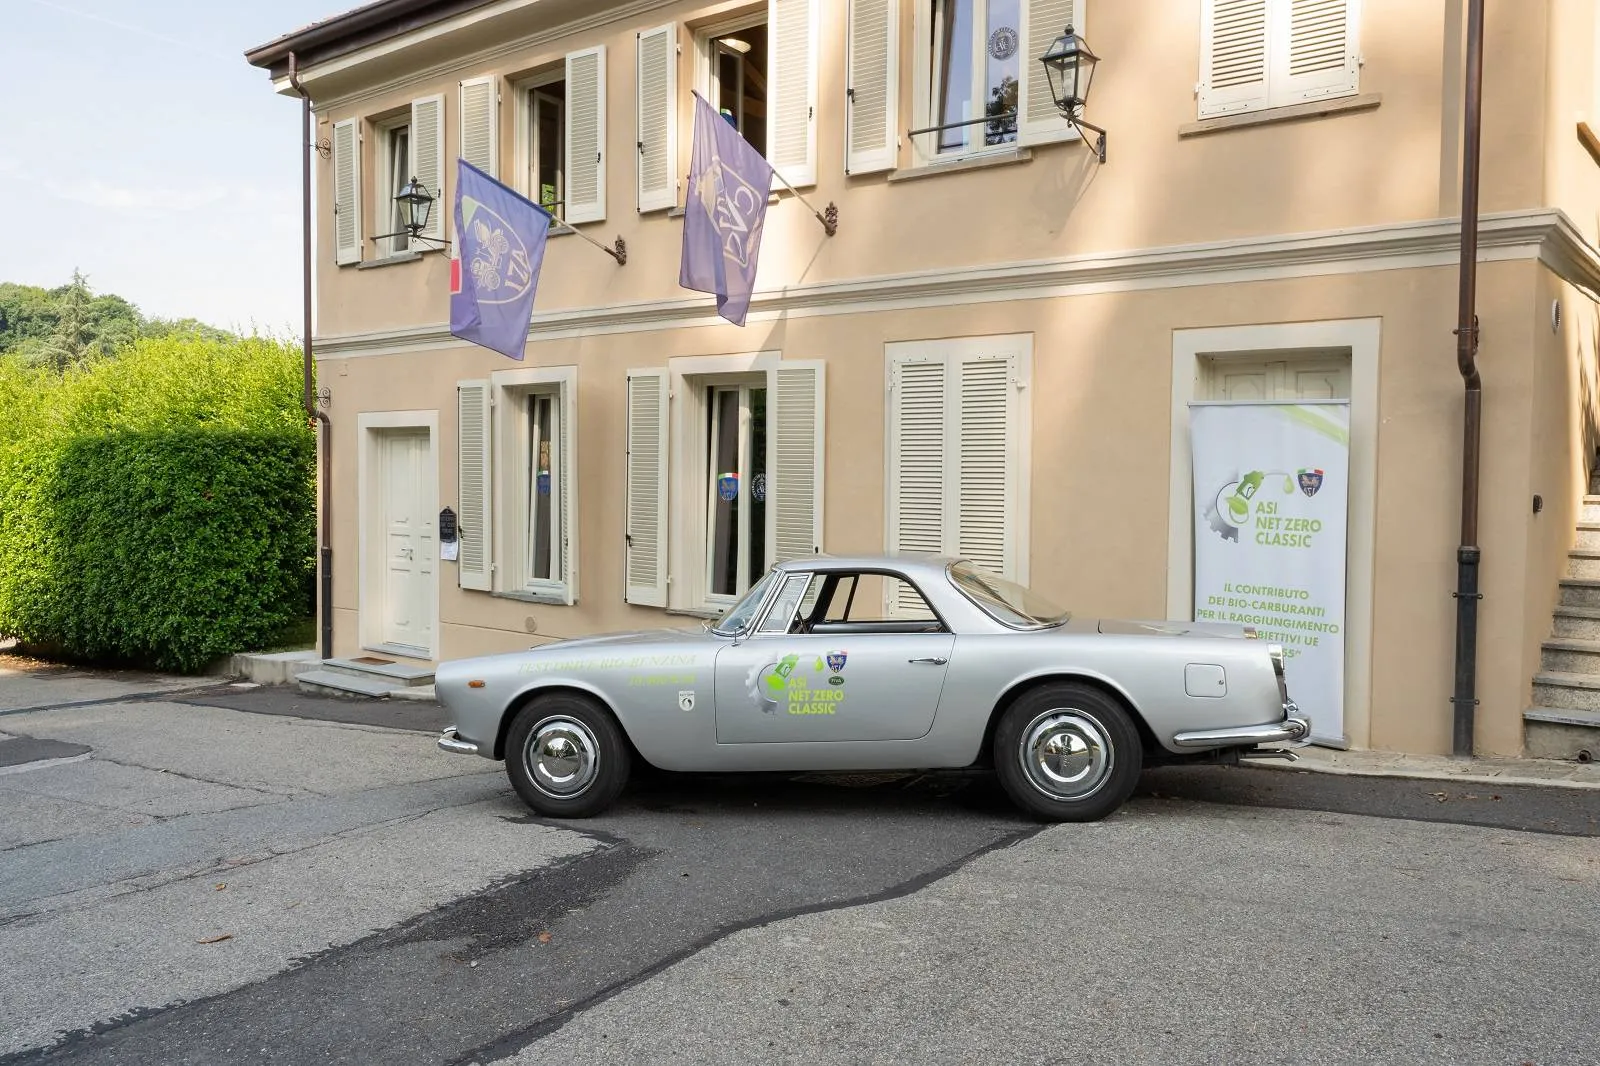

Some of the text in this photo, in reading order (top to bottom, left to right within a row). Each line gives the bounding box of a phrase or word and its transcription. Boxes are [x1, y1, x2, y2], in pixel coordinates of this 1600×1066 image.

[1255, 501, 1278, 514] ASI
[1255, 517, 1322, 533] NET ZERO
[1255, 532, 1312, 548] CLASSIC
[1224, 582, 1310, 600] IL CONTRIBUTO
[1208, 595, 1326, 617] DEI BIO-CARBURANTI
[1197, 608, 1340, 634] PER IL RAGGIUNGIMENTO
[1257, 629, 1319, 647] BIETTIVI UE
[788, 674, 807, 688] ASI
[788, 689, 844, 702] NET ZERO
[788, 702, 836, 715] CLASSIC
